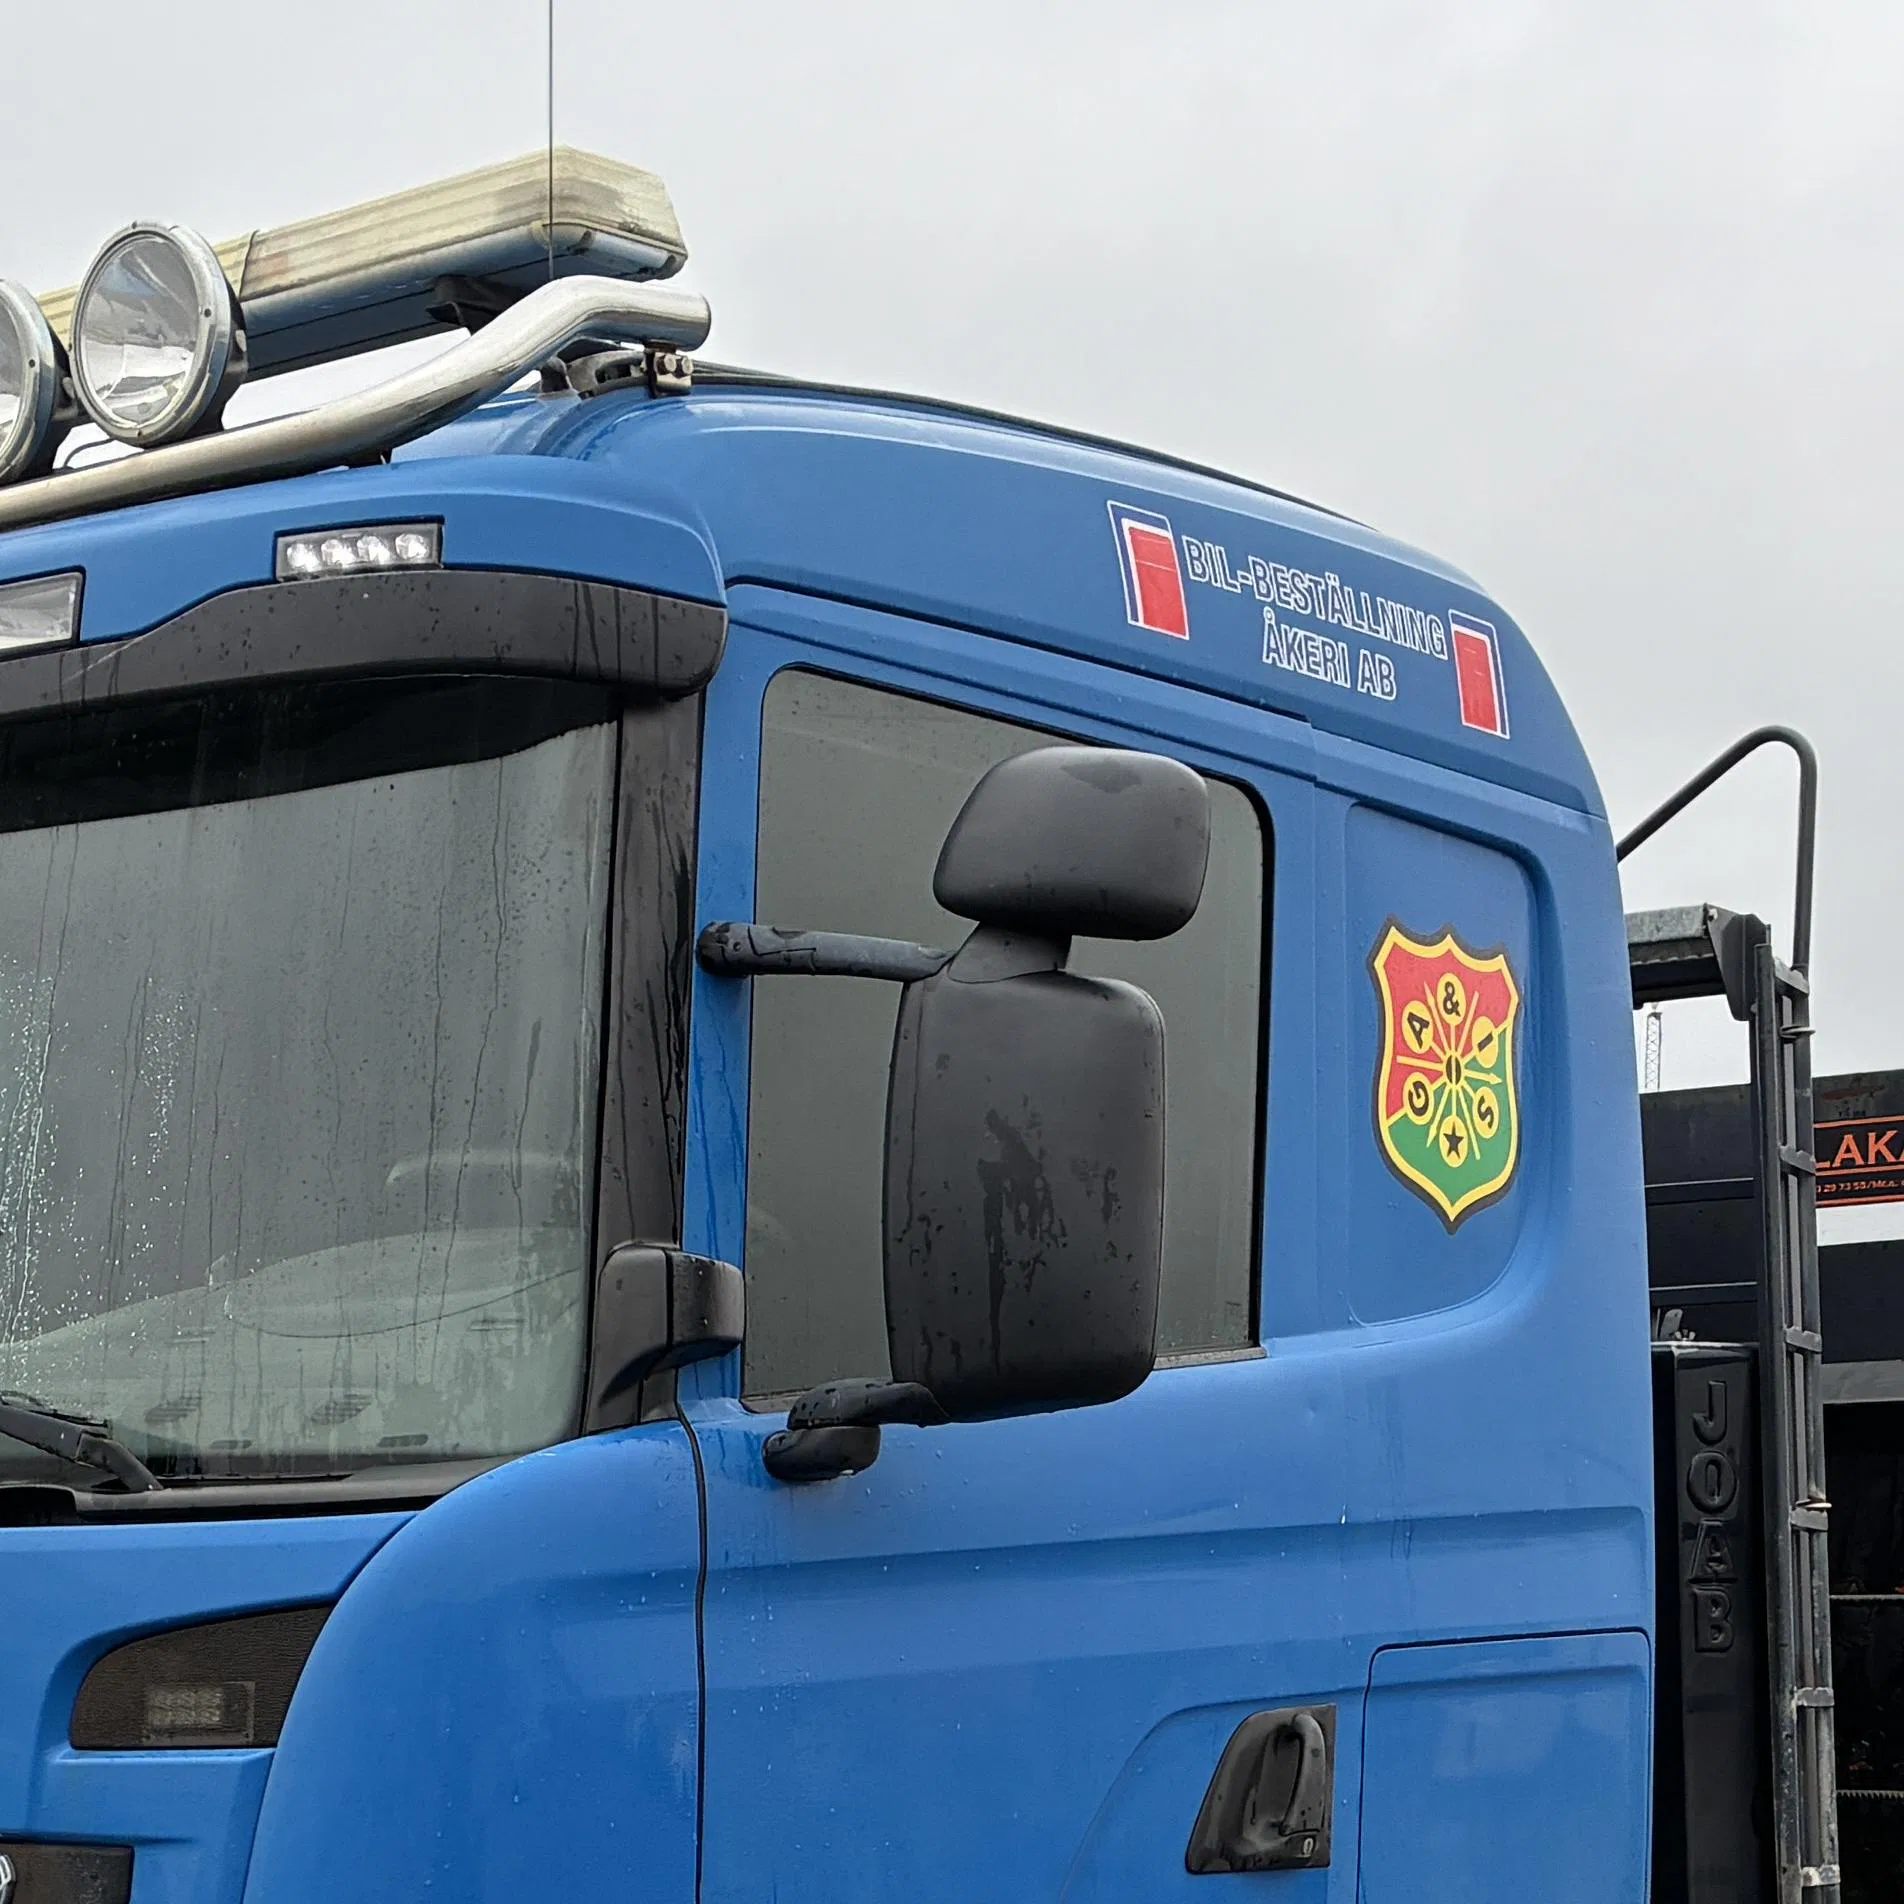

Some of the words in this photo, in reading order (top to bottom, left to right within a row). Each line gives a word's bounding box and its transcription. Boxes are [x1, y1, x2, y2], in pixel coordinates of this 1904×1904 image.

[1182, 536, 1448, 660] BIL-BESTÄLLNING
[1263, 606, 1351, 688] ÅKERI
[1358, 649, 1396, 700] AB
[1685, 1380, 1738, 1653] JOAB
